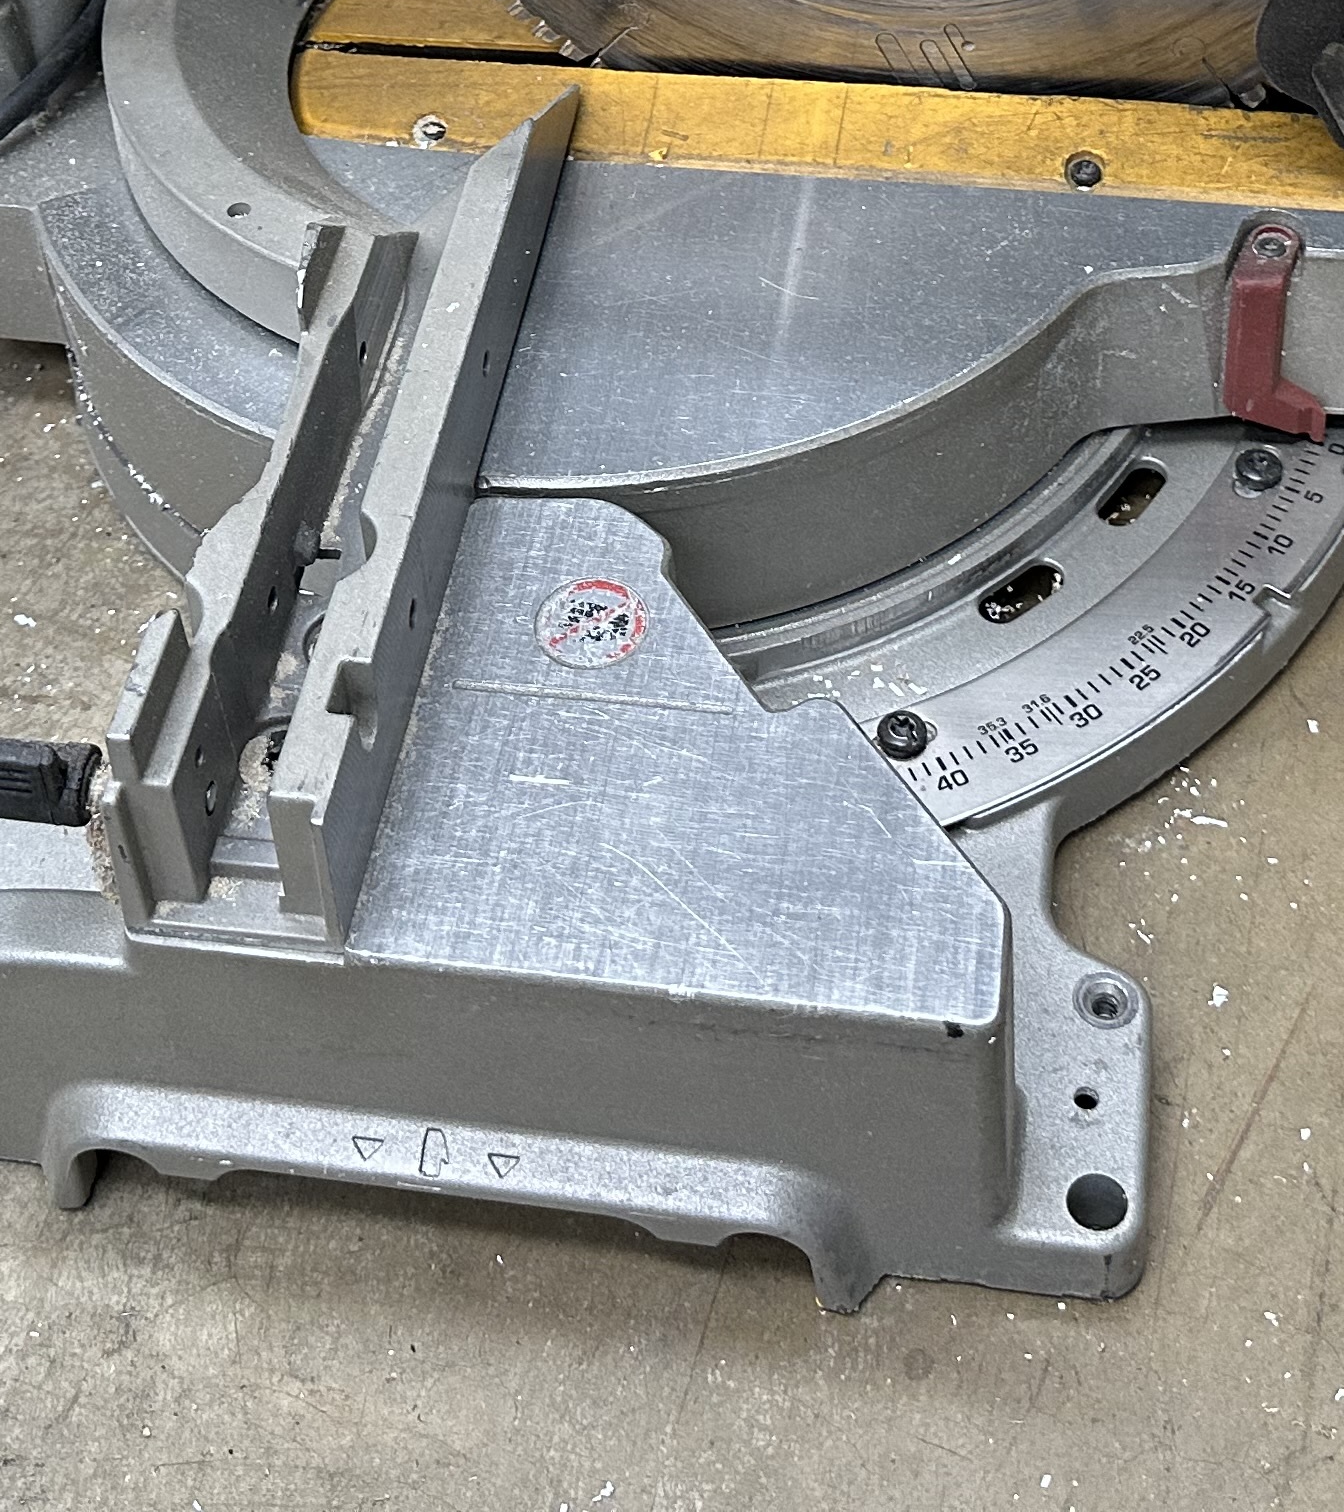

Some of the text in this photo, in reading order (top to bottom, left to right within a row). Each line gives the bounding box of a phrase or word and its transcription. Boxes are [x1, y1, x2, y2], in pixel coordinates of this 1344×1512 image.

[1304, 490, 1324, 504] 5
[1267, 534, 1294, 555] 10
[1228, 580, 1256, 602] 15
[1179, 622, 1211, 648] 20
[1128, 664, 1161, 691] 25
[1069, 703, 1103, 728] 30
[1004, 738, 1039, 763] 35
[937, 769, 970, 791] 40
